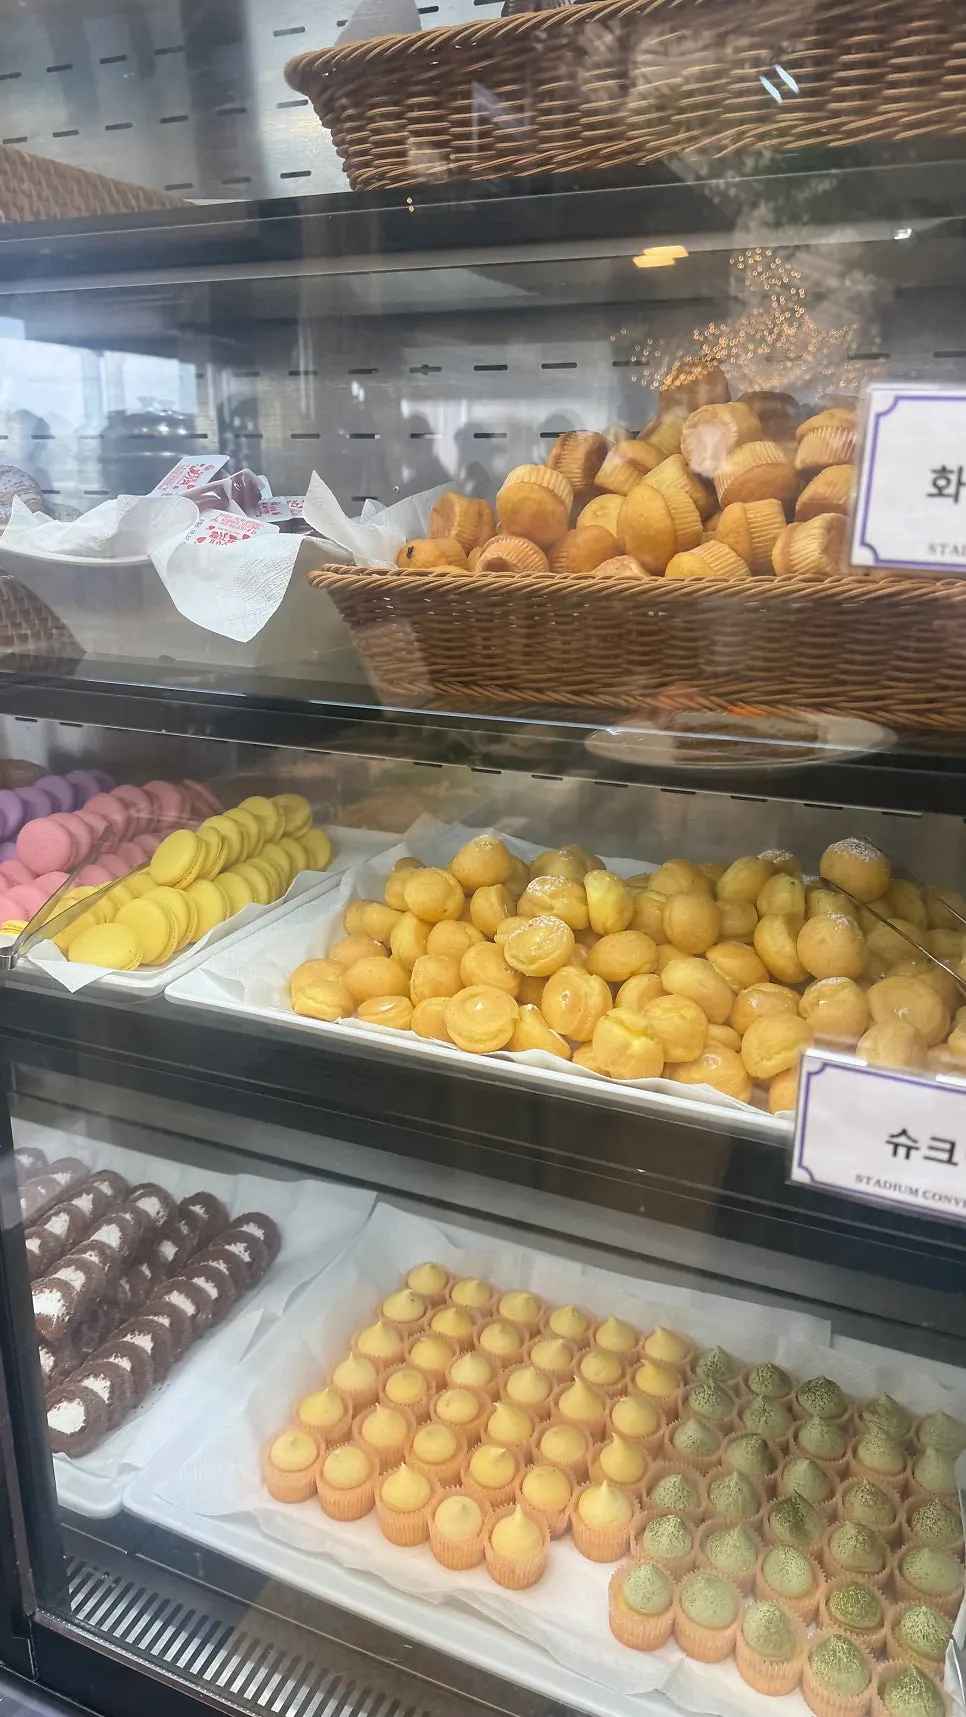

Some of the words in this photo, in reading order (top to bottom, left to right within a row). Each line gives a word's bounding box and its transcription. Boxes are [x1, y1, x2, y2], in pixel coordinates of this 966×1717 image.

[926, 464, 966, 504] 화
[885, 1128, 958, 1167] 슈크
[856, 1174, 919, 1198] STADIUM
